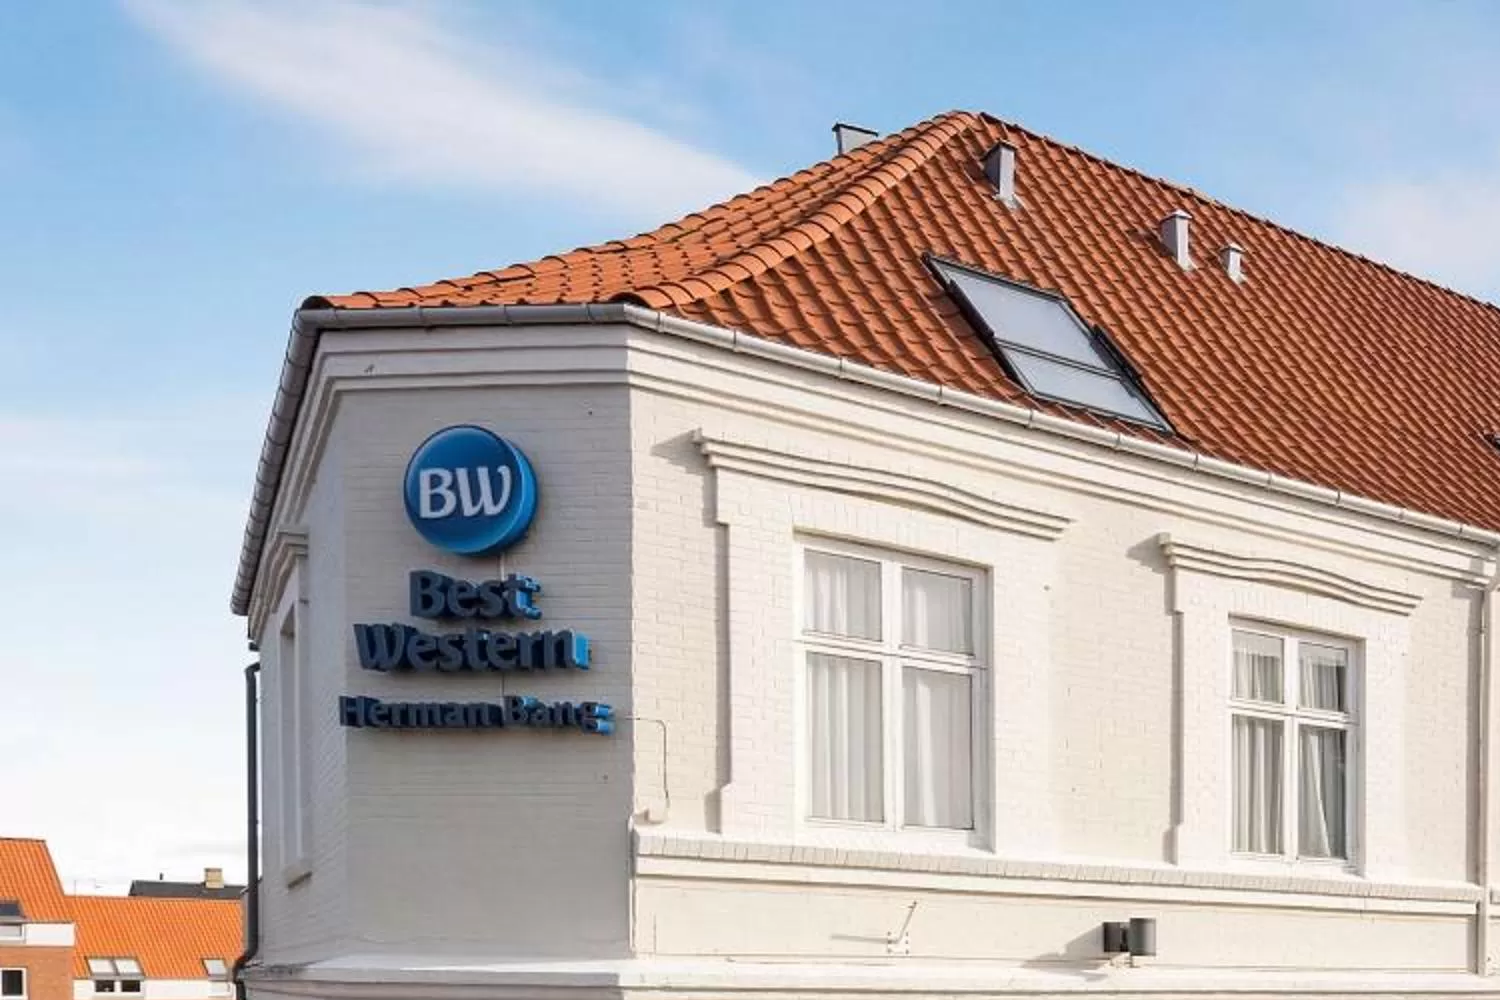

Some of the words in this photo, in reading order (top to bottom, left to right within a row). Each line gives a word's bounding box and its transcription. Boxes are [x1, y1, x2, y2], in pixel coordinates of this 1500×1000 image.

[418, 465, 512, 520] BW
[409, 569, 541, 620] Best
[353, 622, 592, 671] Western
[338, 695, 501, 728] Herman
[503, 695, 615, 735] Bang
